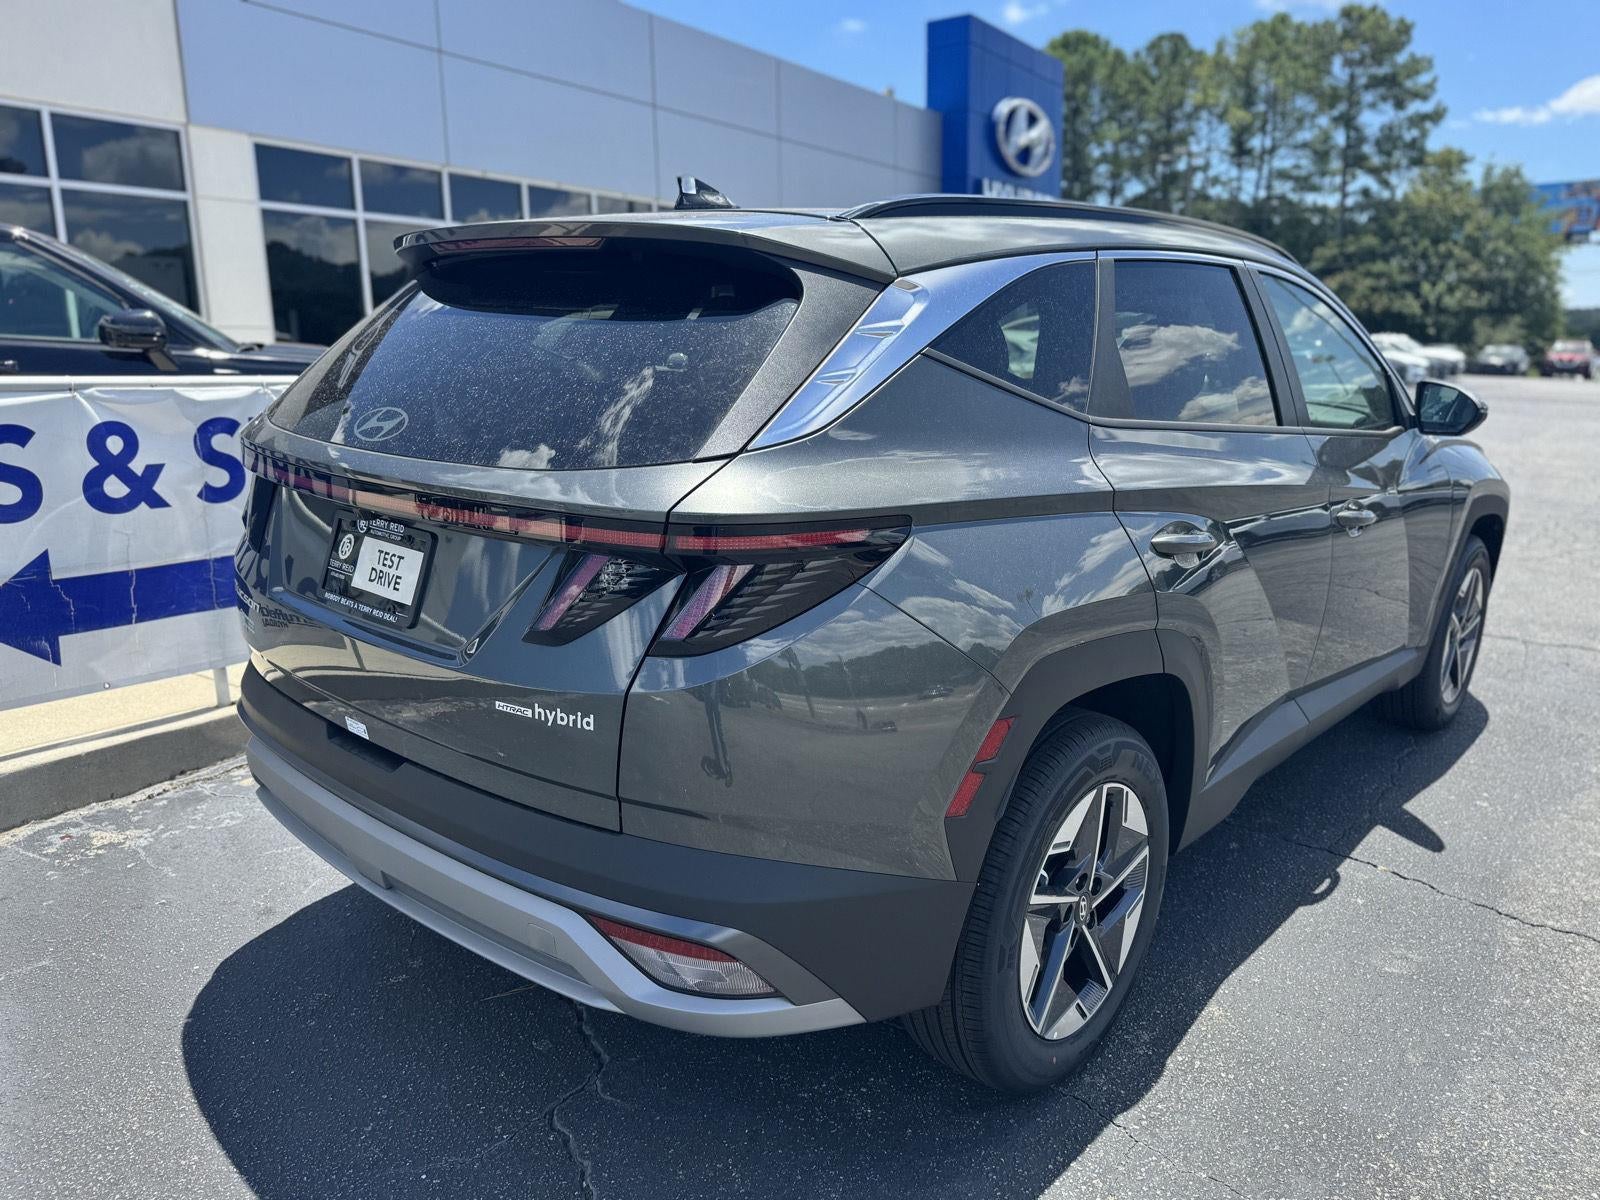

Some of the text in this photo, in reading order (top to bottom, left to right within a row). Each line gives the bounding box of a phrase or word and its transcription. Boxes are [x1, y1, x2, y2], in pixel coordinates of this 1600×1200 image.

[82, 420, 171, 514] &
[390, 521, 405, 533] REID
[378, 549, 405, 571] TEST
[368, 566, 402, 592] DRIVE
[340, 597, 354, 608] BEATS
[358, 603, 372, 614] TERRY
[372, 608, 384, 618] REID
[496, 702, 594, 731] HTRAC hybrid
